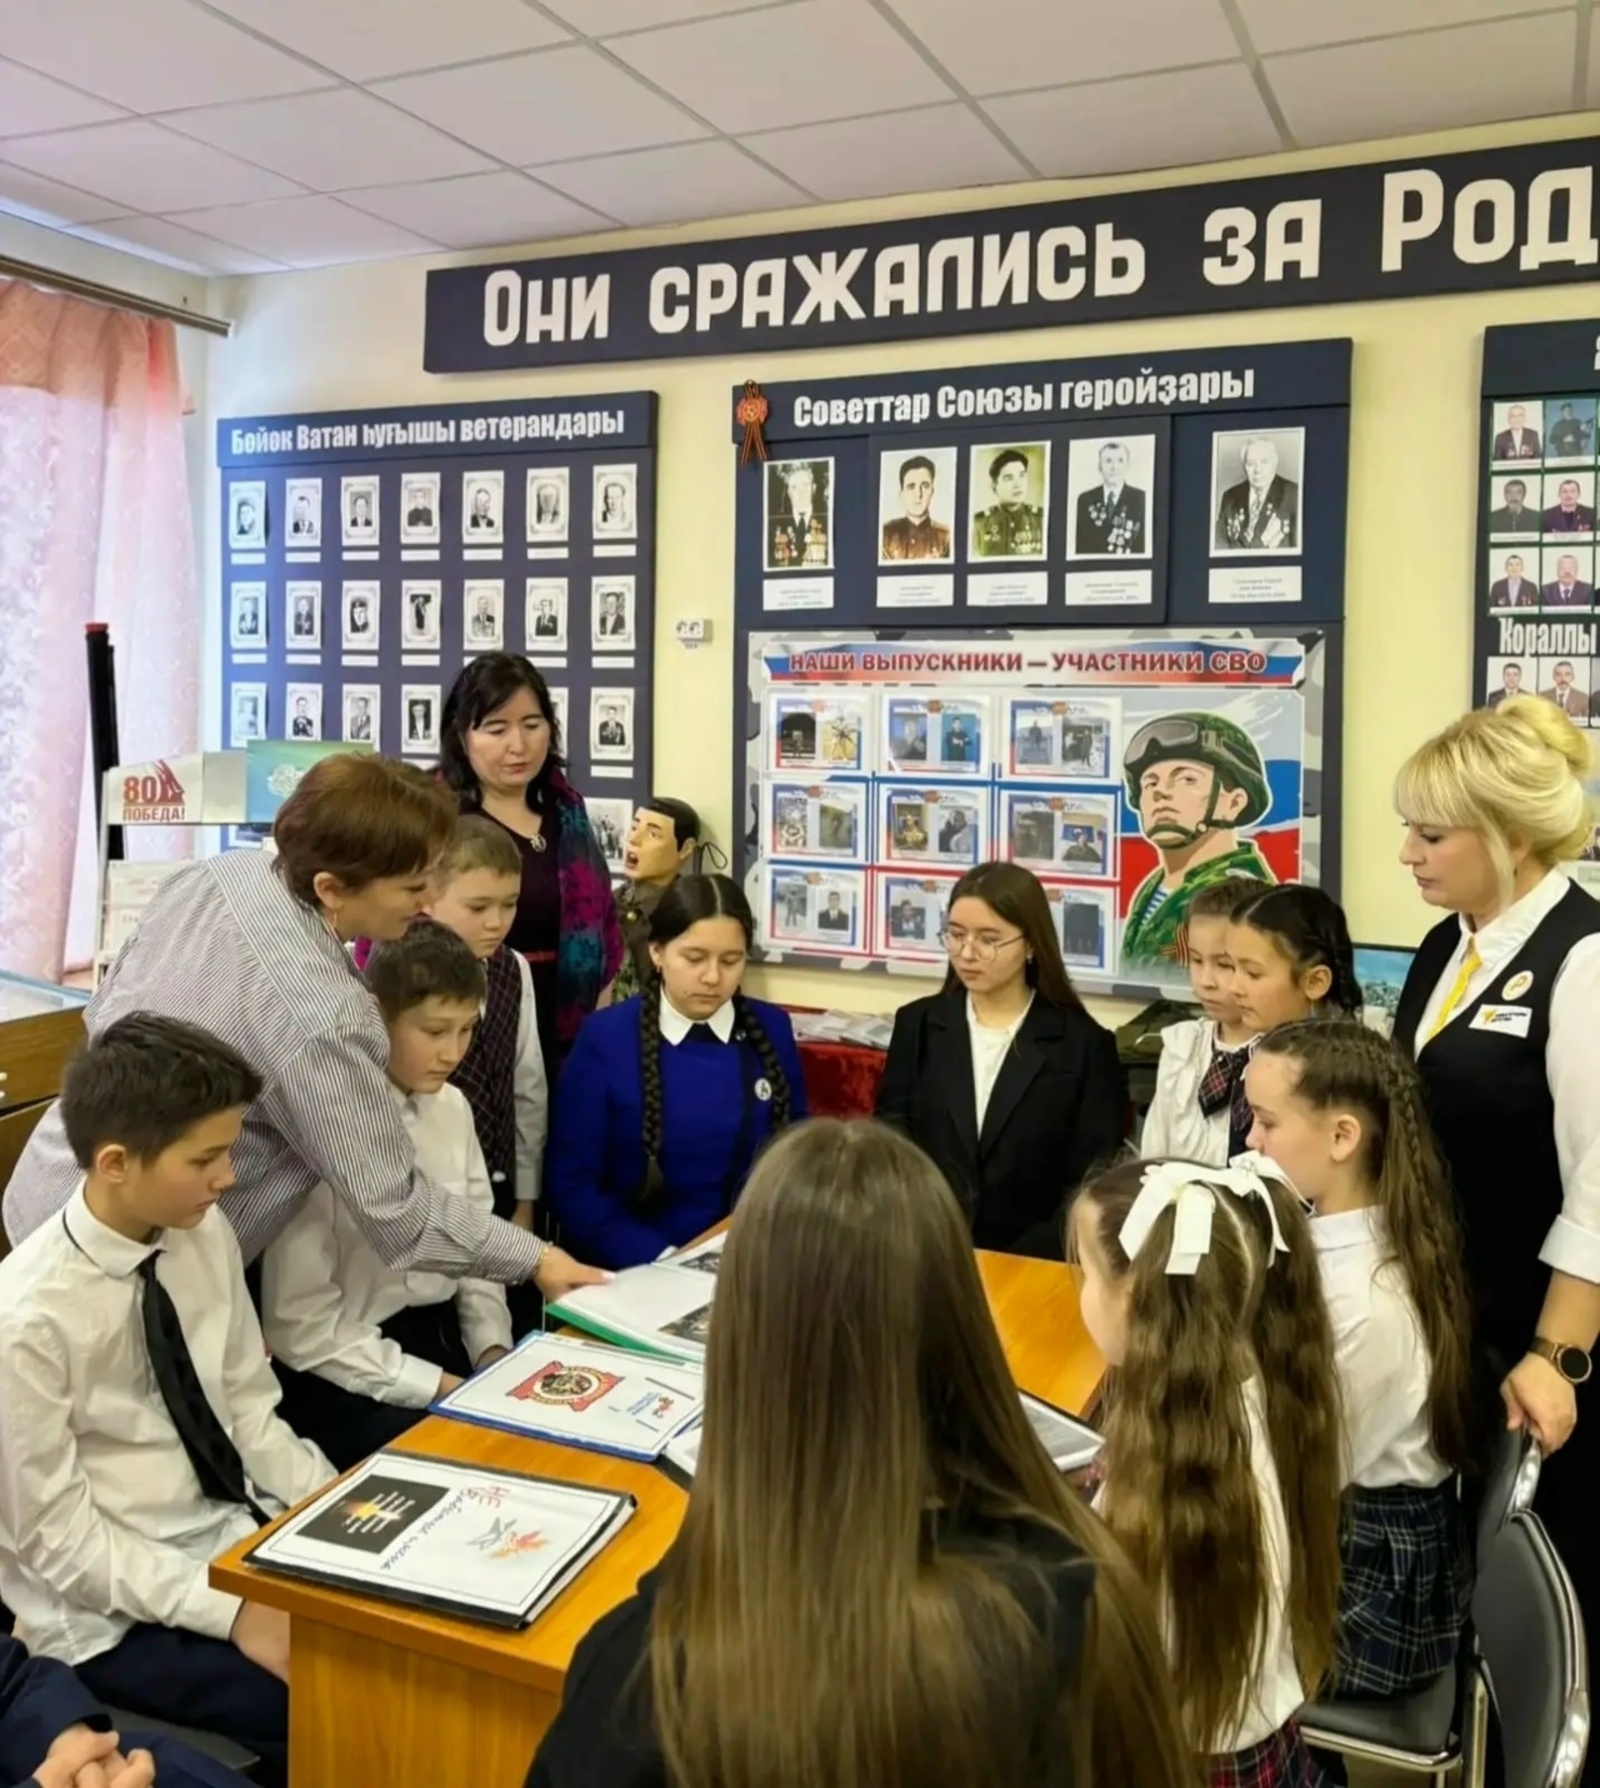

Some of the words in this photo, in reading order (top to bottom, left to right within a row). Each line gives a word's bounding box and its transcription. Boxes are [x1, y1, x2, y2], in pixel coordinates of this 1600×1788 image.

[793, 395, 931, 428] Советтар
[936, 383, 1054, 418] Союзы
[296, 424, 358, 451] Ватан
[460, 410, 625, 442] ветерандары
[790, 653, 854, 671] НАШИ
[862, 653, 1023, 672] ВЫПУСКНИКИ
[1052, 652, 1203, 672] УЧАСТНИКИ
[1209, 652, 1266, 673] СВО
[122, 806, 186, 822] ПОБЕДА!
